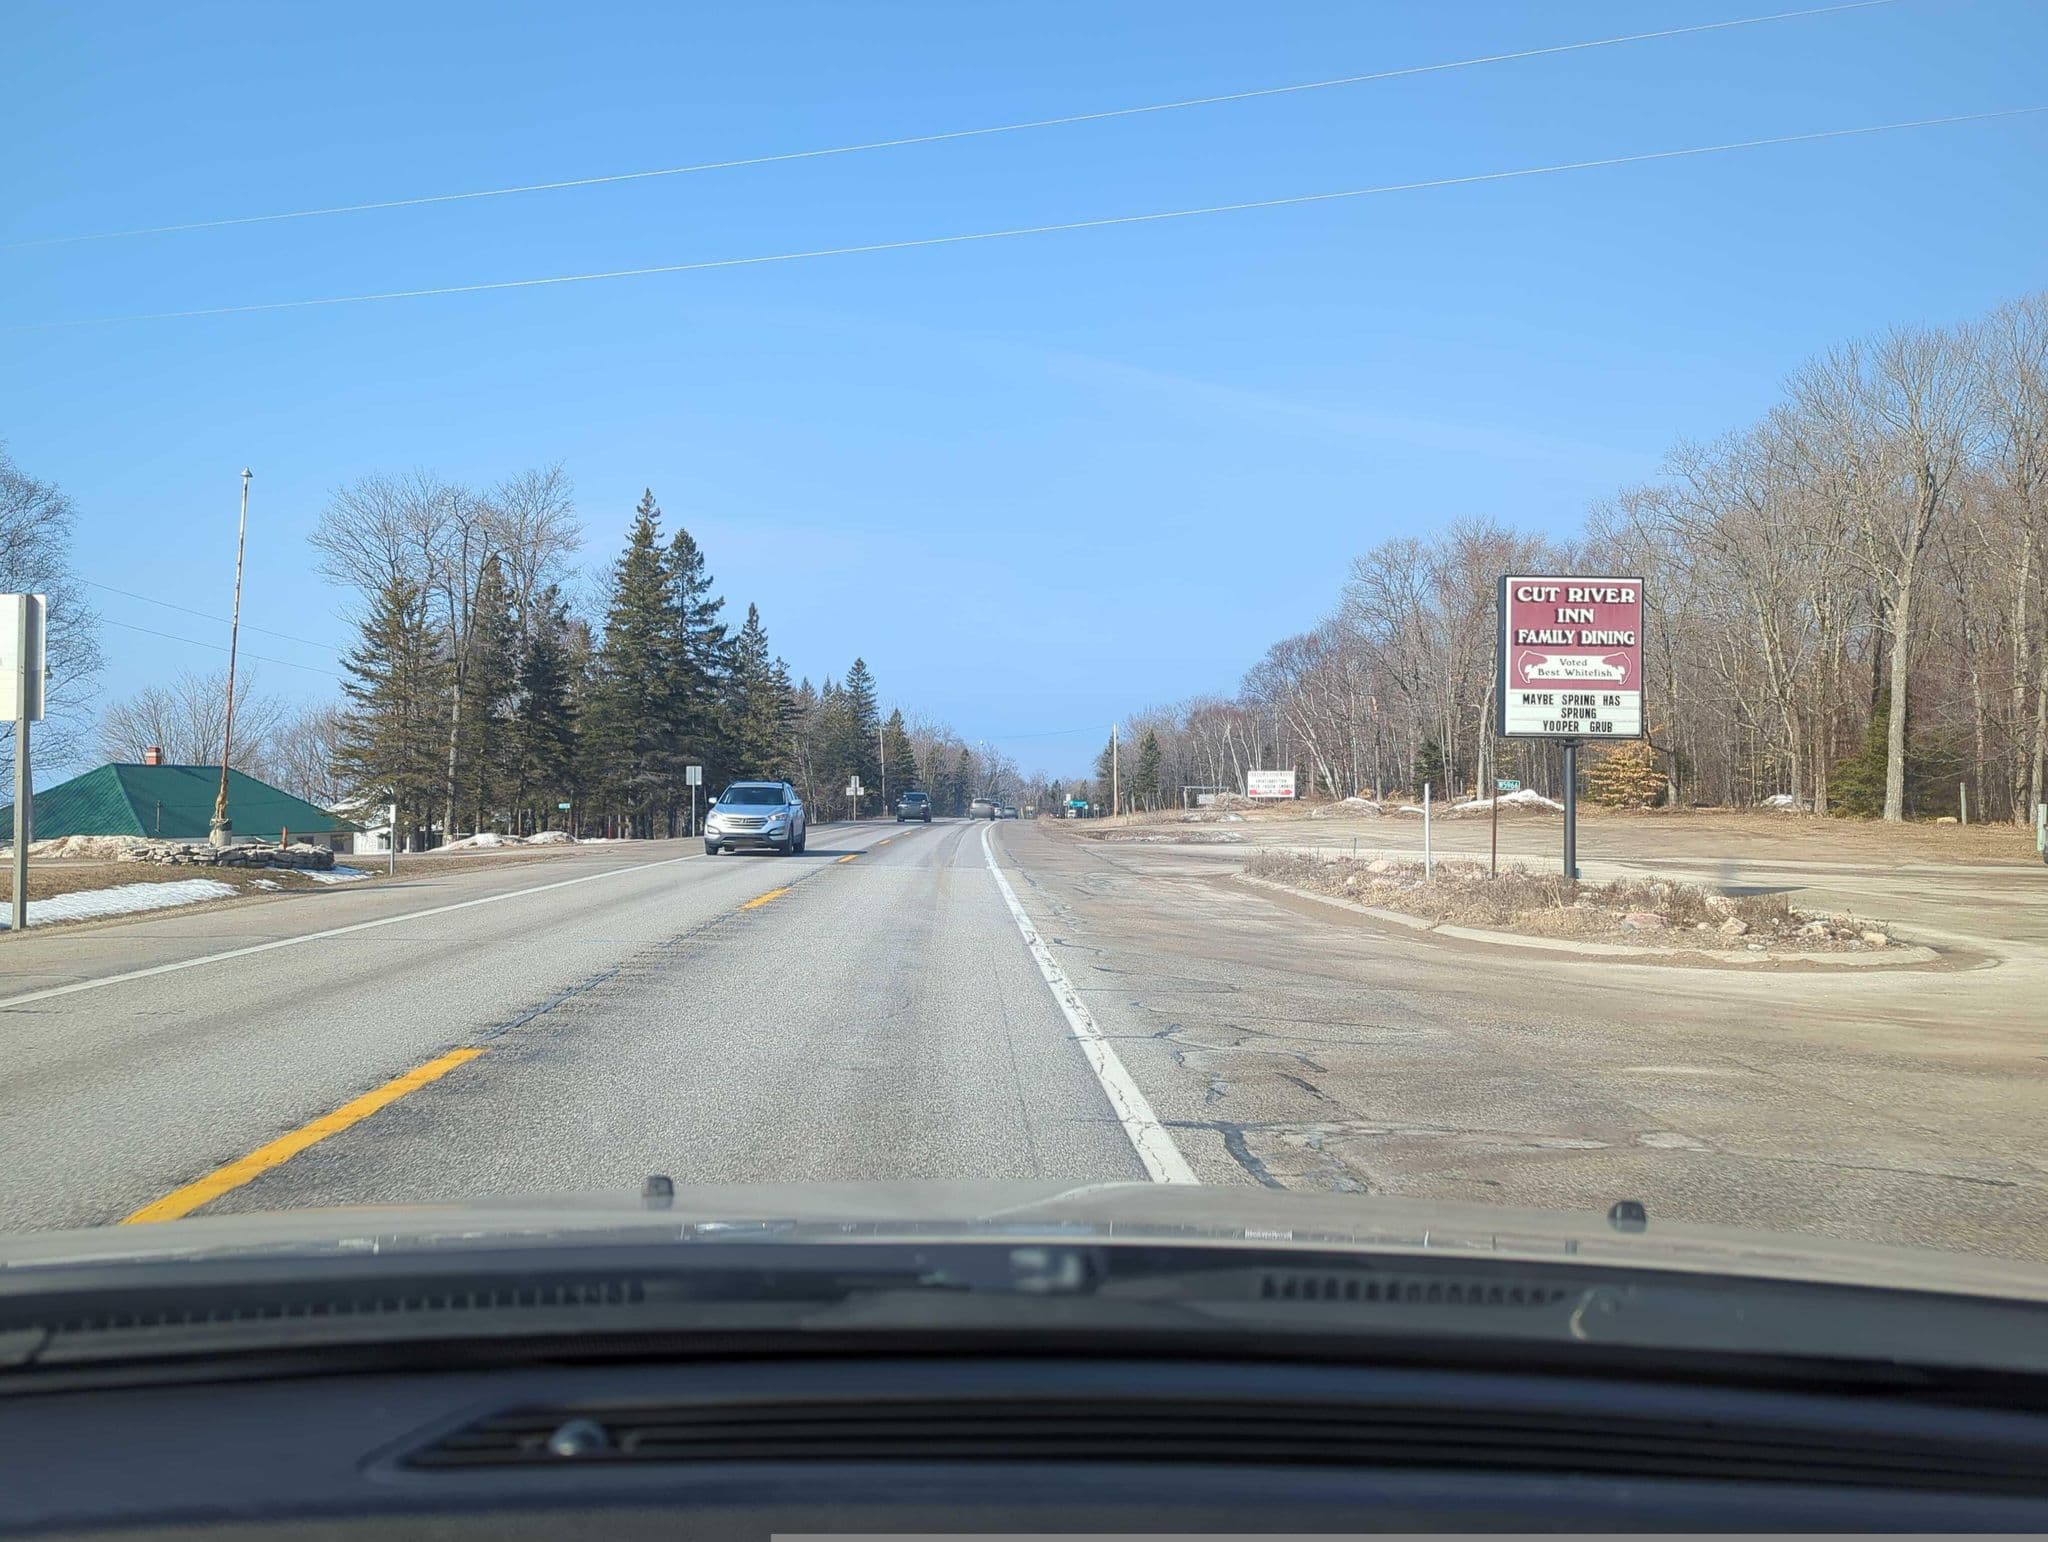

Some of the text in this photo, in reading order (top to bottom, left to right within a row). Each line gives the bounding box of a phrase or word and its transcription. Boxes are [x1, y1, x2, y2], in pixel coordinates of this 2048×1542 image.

[1517, 586, 1635, 604] CUT RIVER
[1557, 608, 1595, 624] INN
[1517, 629, 1635, 646] FAMILY DINING
[1560, 658, 1587, 667] Voted
[1538, 668, 1613, 678] Best Whitefish
[1522, 694, 1620, 706] MAYBE SPRING HAS
[1561, 708, 1597, 719] SPRUNG
[1543, 721, 1613, 733] YOOPER GRUB
